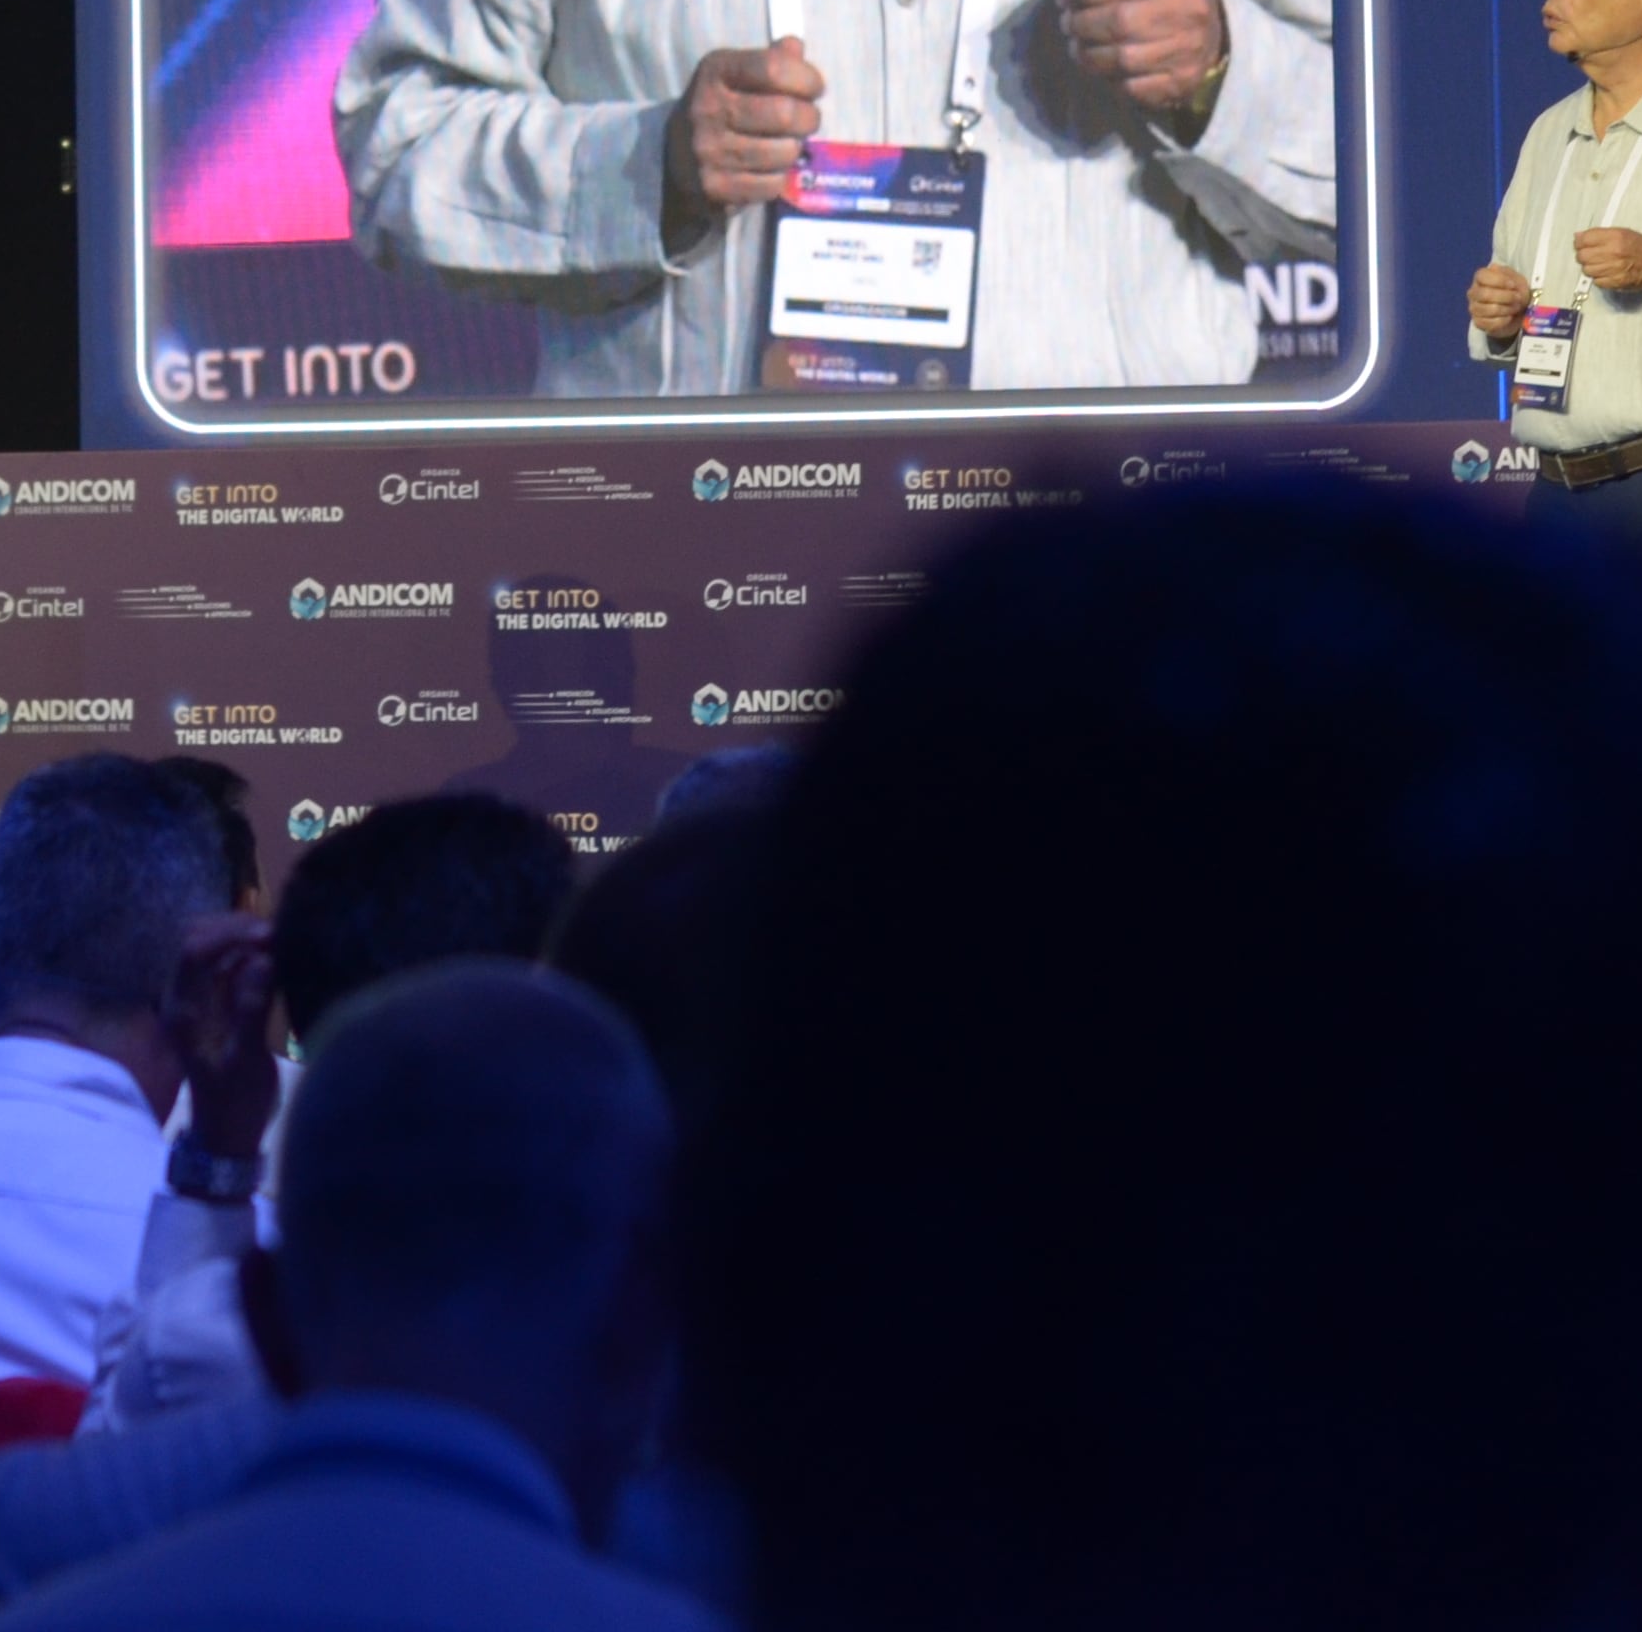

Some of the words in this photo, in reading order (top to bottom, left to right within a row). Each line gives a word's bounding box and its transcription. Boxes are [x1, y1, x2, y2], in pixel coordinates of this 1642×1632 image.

[155, 347, 265, 403] GET
[283, 340, 416, 397] INTO
[733, 462, 861, 488] ANDICOM
[905, 470, 950, 490] GET
[957, 469, 1011, 488] INTO
[14, 478, 136, 504] ANDICOM
[175, 485, 220, 505] GET
[226, 484, 278, 504] INTO
[410, 480, 480, 500] Cintel
[905, 494, 938, 511] THE
[942, 492, 1012, 510] DIGITAL
[176, 509, 208, 526] THE
[211, 508, 278, 525] DIGITAL
[281, 506, 344, 523] WORLD
[329, 583, 453, 607] ANDICOM
[495, 590, 540, 610] GET
[547, 589, 600, 608] INTO
[736, 585, 807, 606] Cintel
[16, 598, 84, 618] Cintel
[495, 613, 528, 630] THE
[532, 612, 600, 629] DIGITAL
[602, 611, 668, 628] WORLD
[12, 698, 134, 722] ANDICOM
[174, 705, 218, 725] GET
[224, 704, 276, 724] INTO
[409, 702, 478, 722] Cintel
[174, 729, 206, 745] THE
[209, 728, 276, 745] DIGITAL
[279, 727, 343, 743] WORLD
